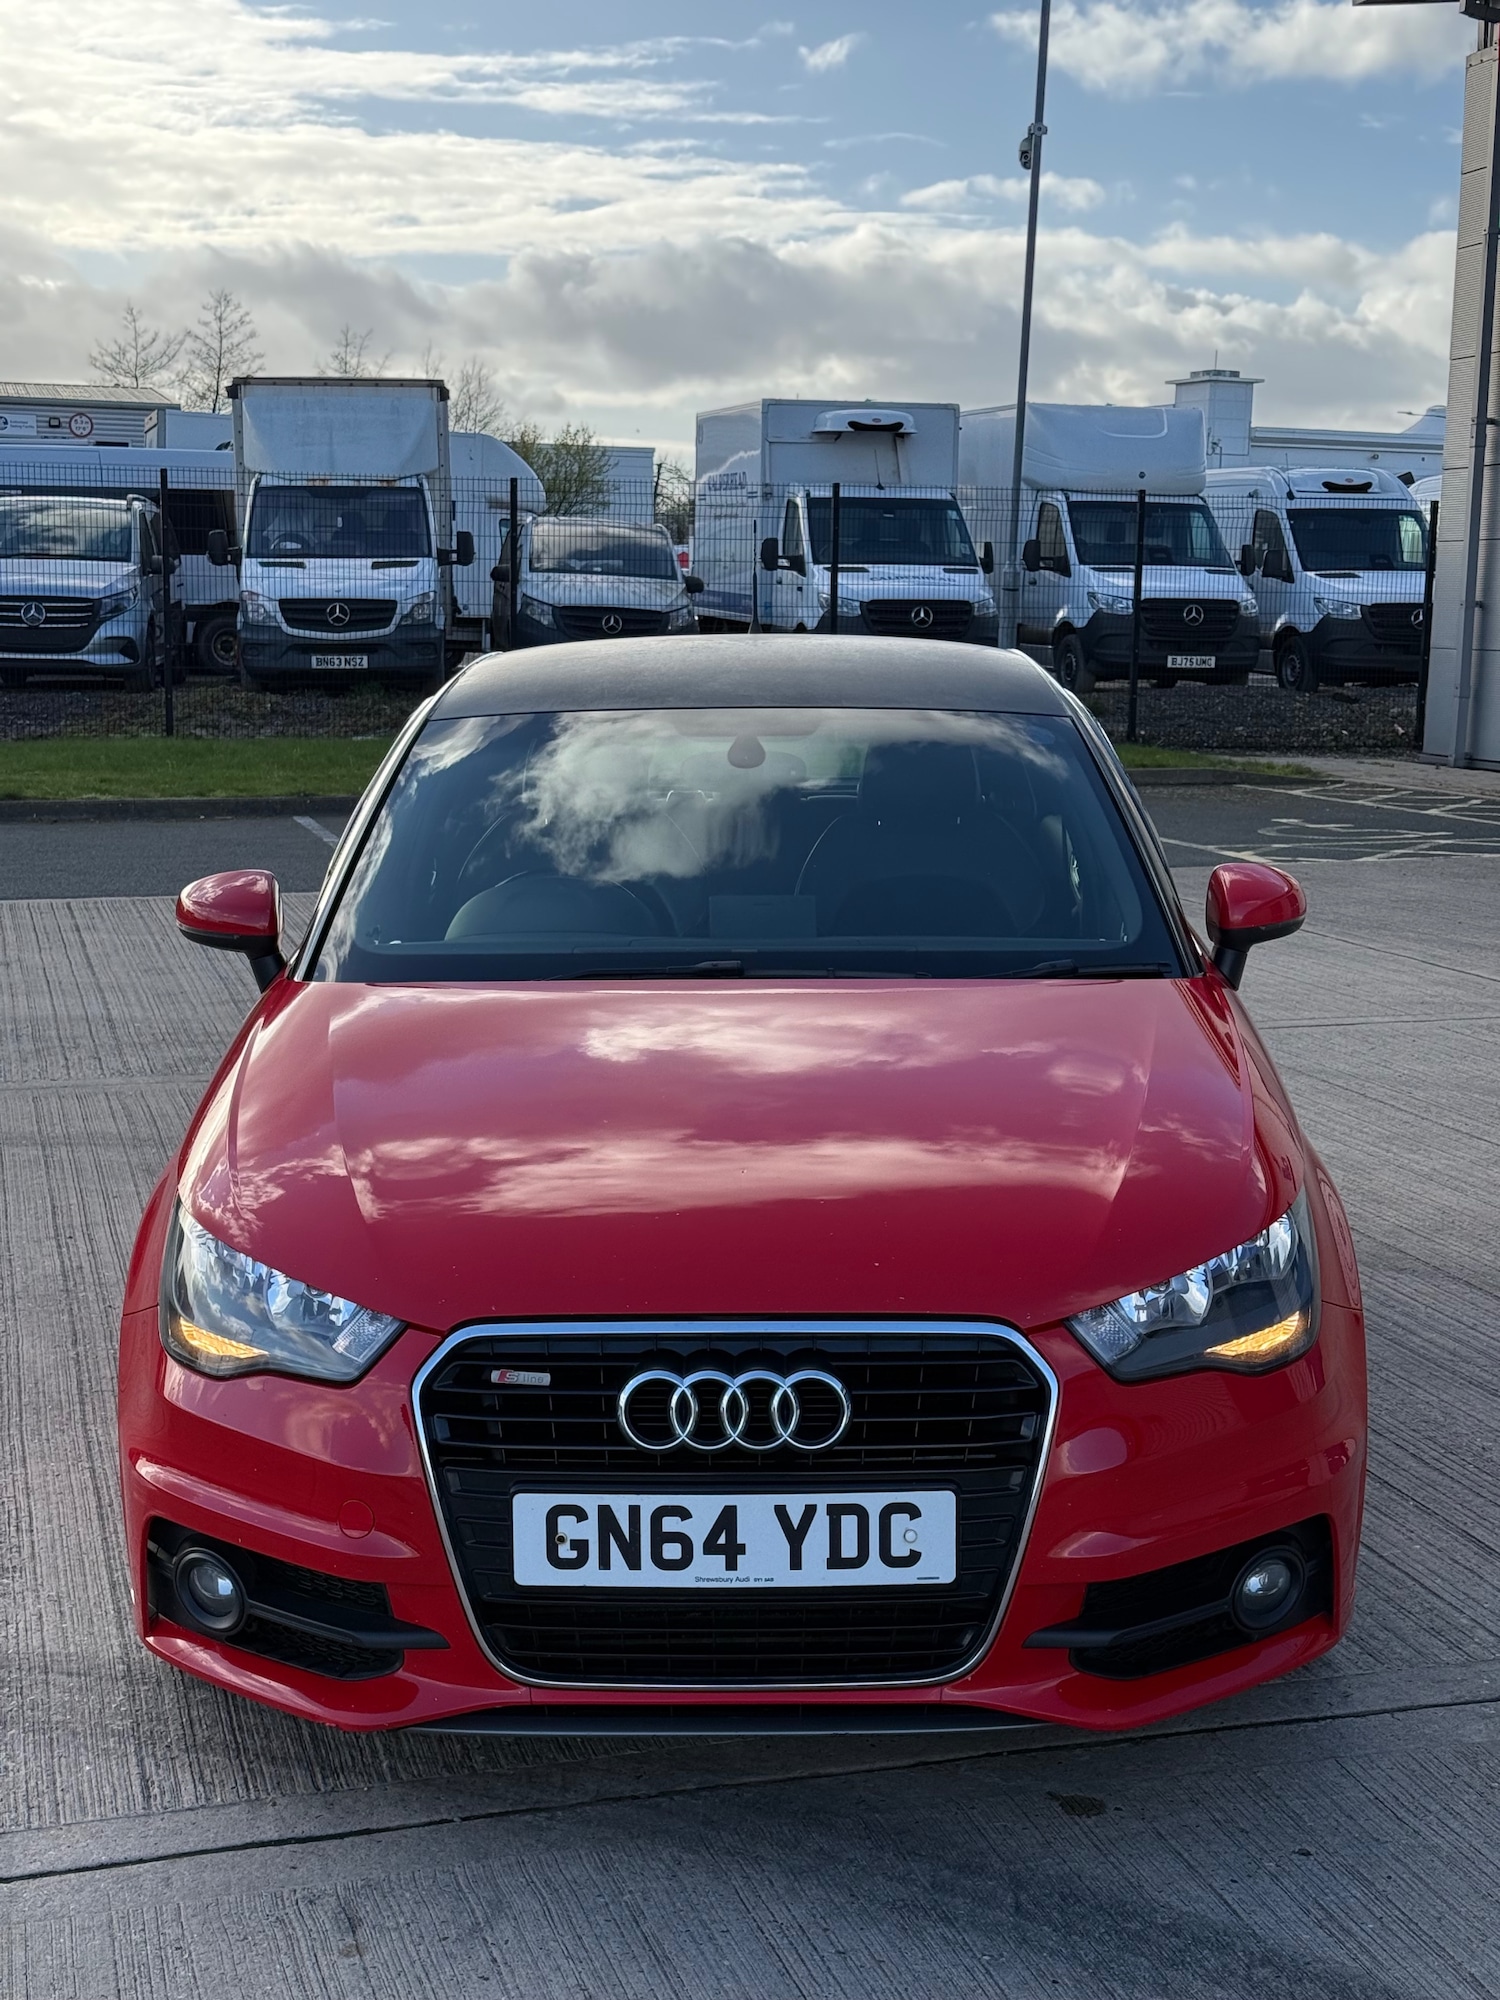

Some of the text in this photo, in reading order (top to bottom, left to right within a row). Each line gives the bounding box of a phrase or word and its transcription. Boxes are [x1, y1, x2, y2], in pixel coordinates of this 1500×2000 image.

[315, 657, 364, 667] BN63 NSZ
[1171, 657, 1195, 667] BJ75
[523, 1373, 544, 1384] line
[545, 1502, 922, 1572] GN64 YDC
[694, 1576, 734, 1584] Shrewsbury
[735, 1575, 751, 1583] Audi
